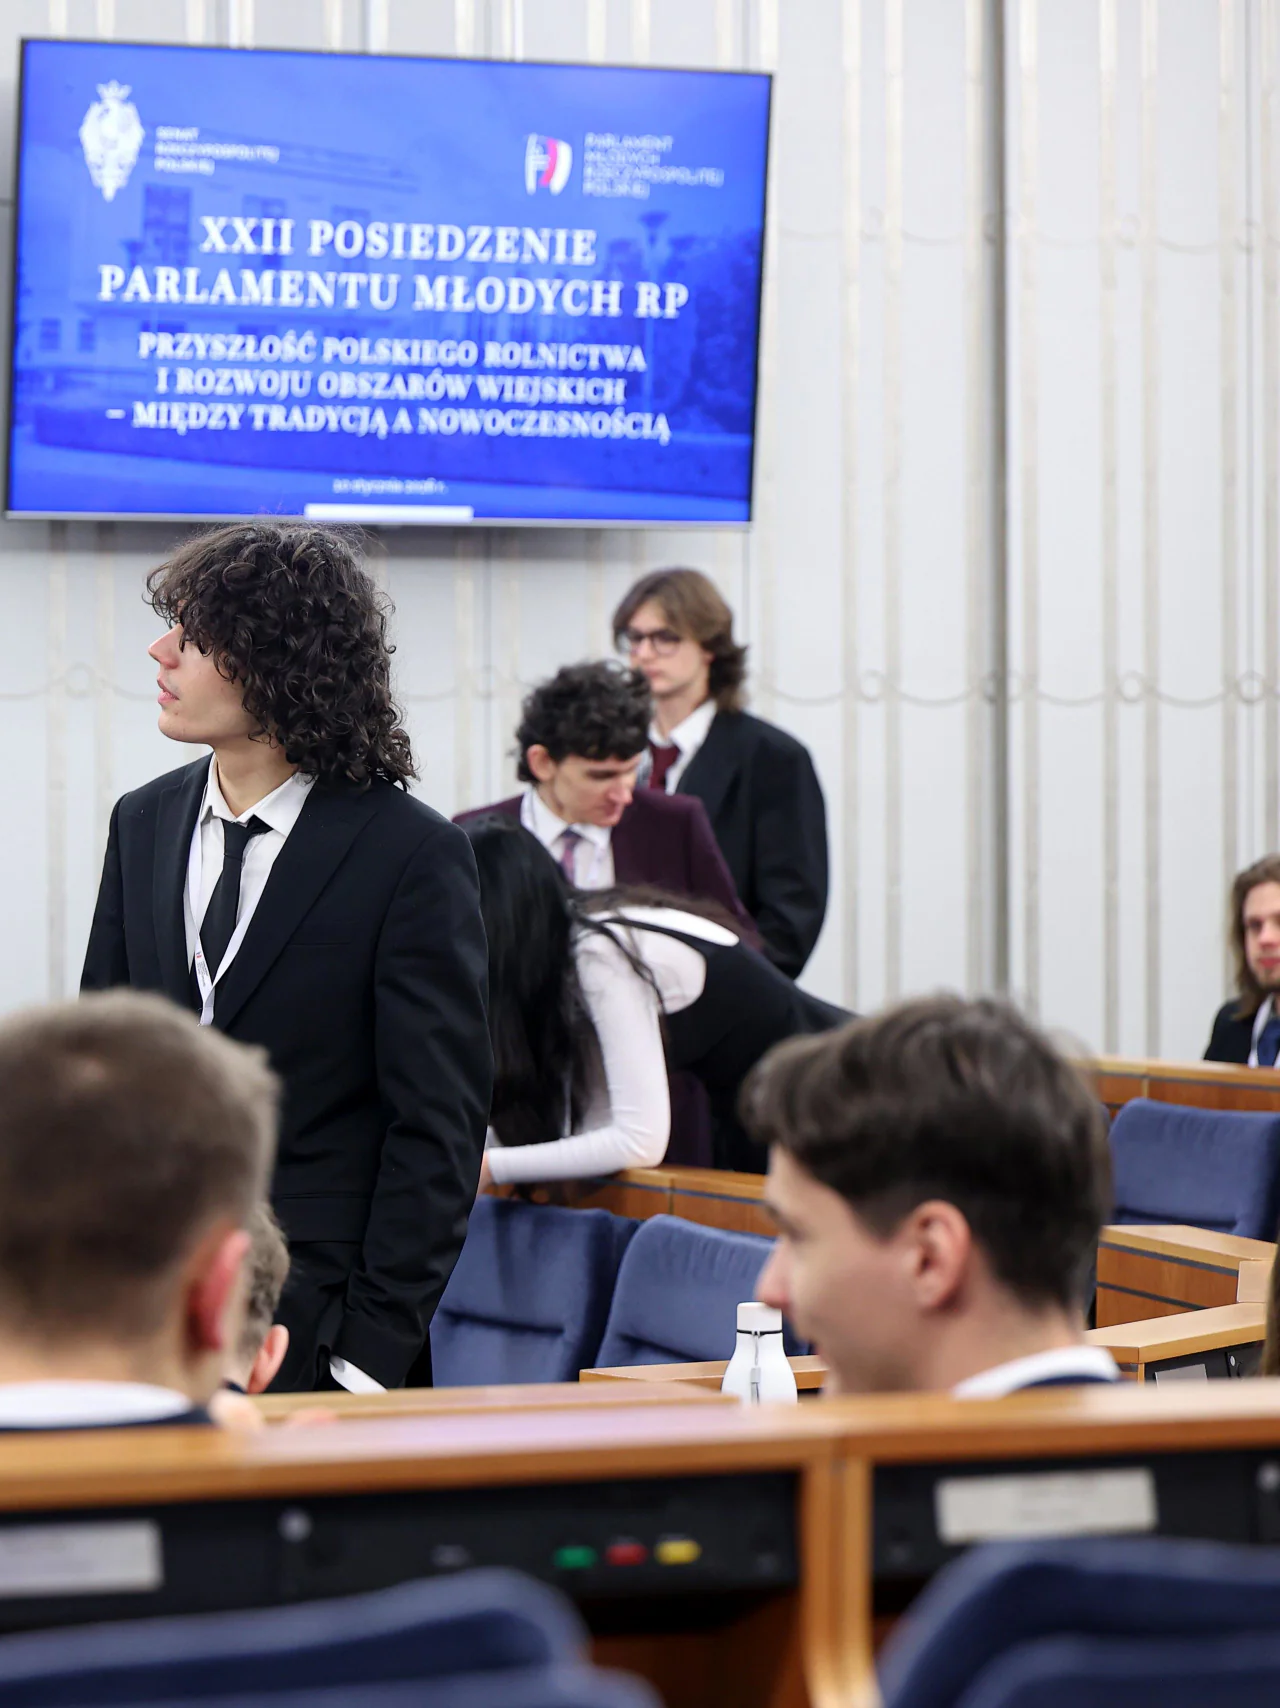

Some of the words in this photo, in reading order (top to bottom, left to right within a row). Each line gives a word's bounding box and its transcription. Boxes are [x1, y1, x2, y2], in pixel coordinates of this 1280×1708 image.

[199, 216, 295, 255] XXII
[308, 219, 597, 266] POSIEDZENIE
[97, 264, 401, 310] PARLAMENTU
[412, 274, 623, 317] MŁODYCH
[634, 281, 689, 319] RP
[139, 330, 317, 363] PRZYSZŁOŚĆ
[322, 337, 478, 367] POLSKIEGO
[484, 341, 647, 372] ROLNICTWA
[156, 366, 169, 394] I
[176, 367, 312, 400] ROZWOJU
[318, 368, 473, 401] OBSZARÓW
[476, 374, 628, 407] WIEJSKICH
[132, 401, 245, 436] MIĘDZY
[247, 403, 388, 440] TRADYCJĄ
[391, 407, 414, 434] A
[418, 406, 671, 447] NOWOCZESNOŚCIĄ
